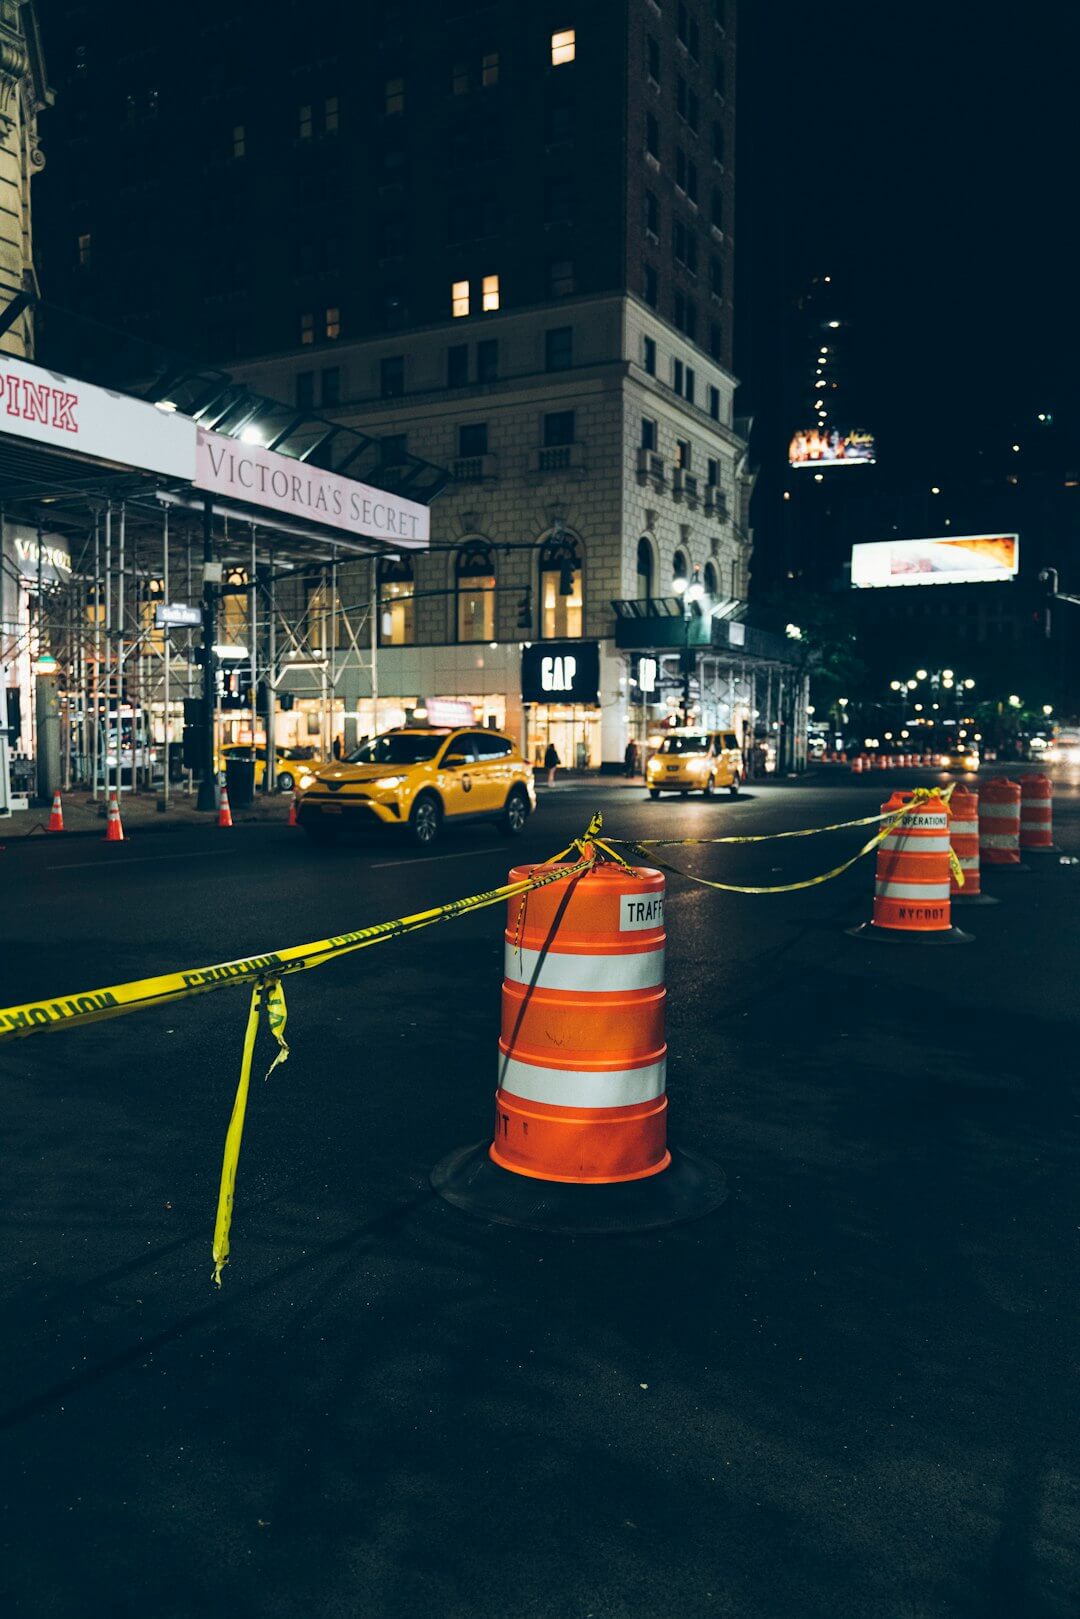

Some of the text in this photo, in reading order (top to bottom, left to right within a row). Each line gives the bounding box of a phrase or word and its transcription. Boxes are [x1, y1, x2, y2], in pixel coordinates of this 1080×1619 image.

[207, 443, 420, 538] VICTORIA'S SECRET
[541, 656, 576, 691] GAP
[627, 900, 664, 922] TRAFF
